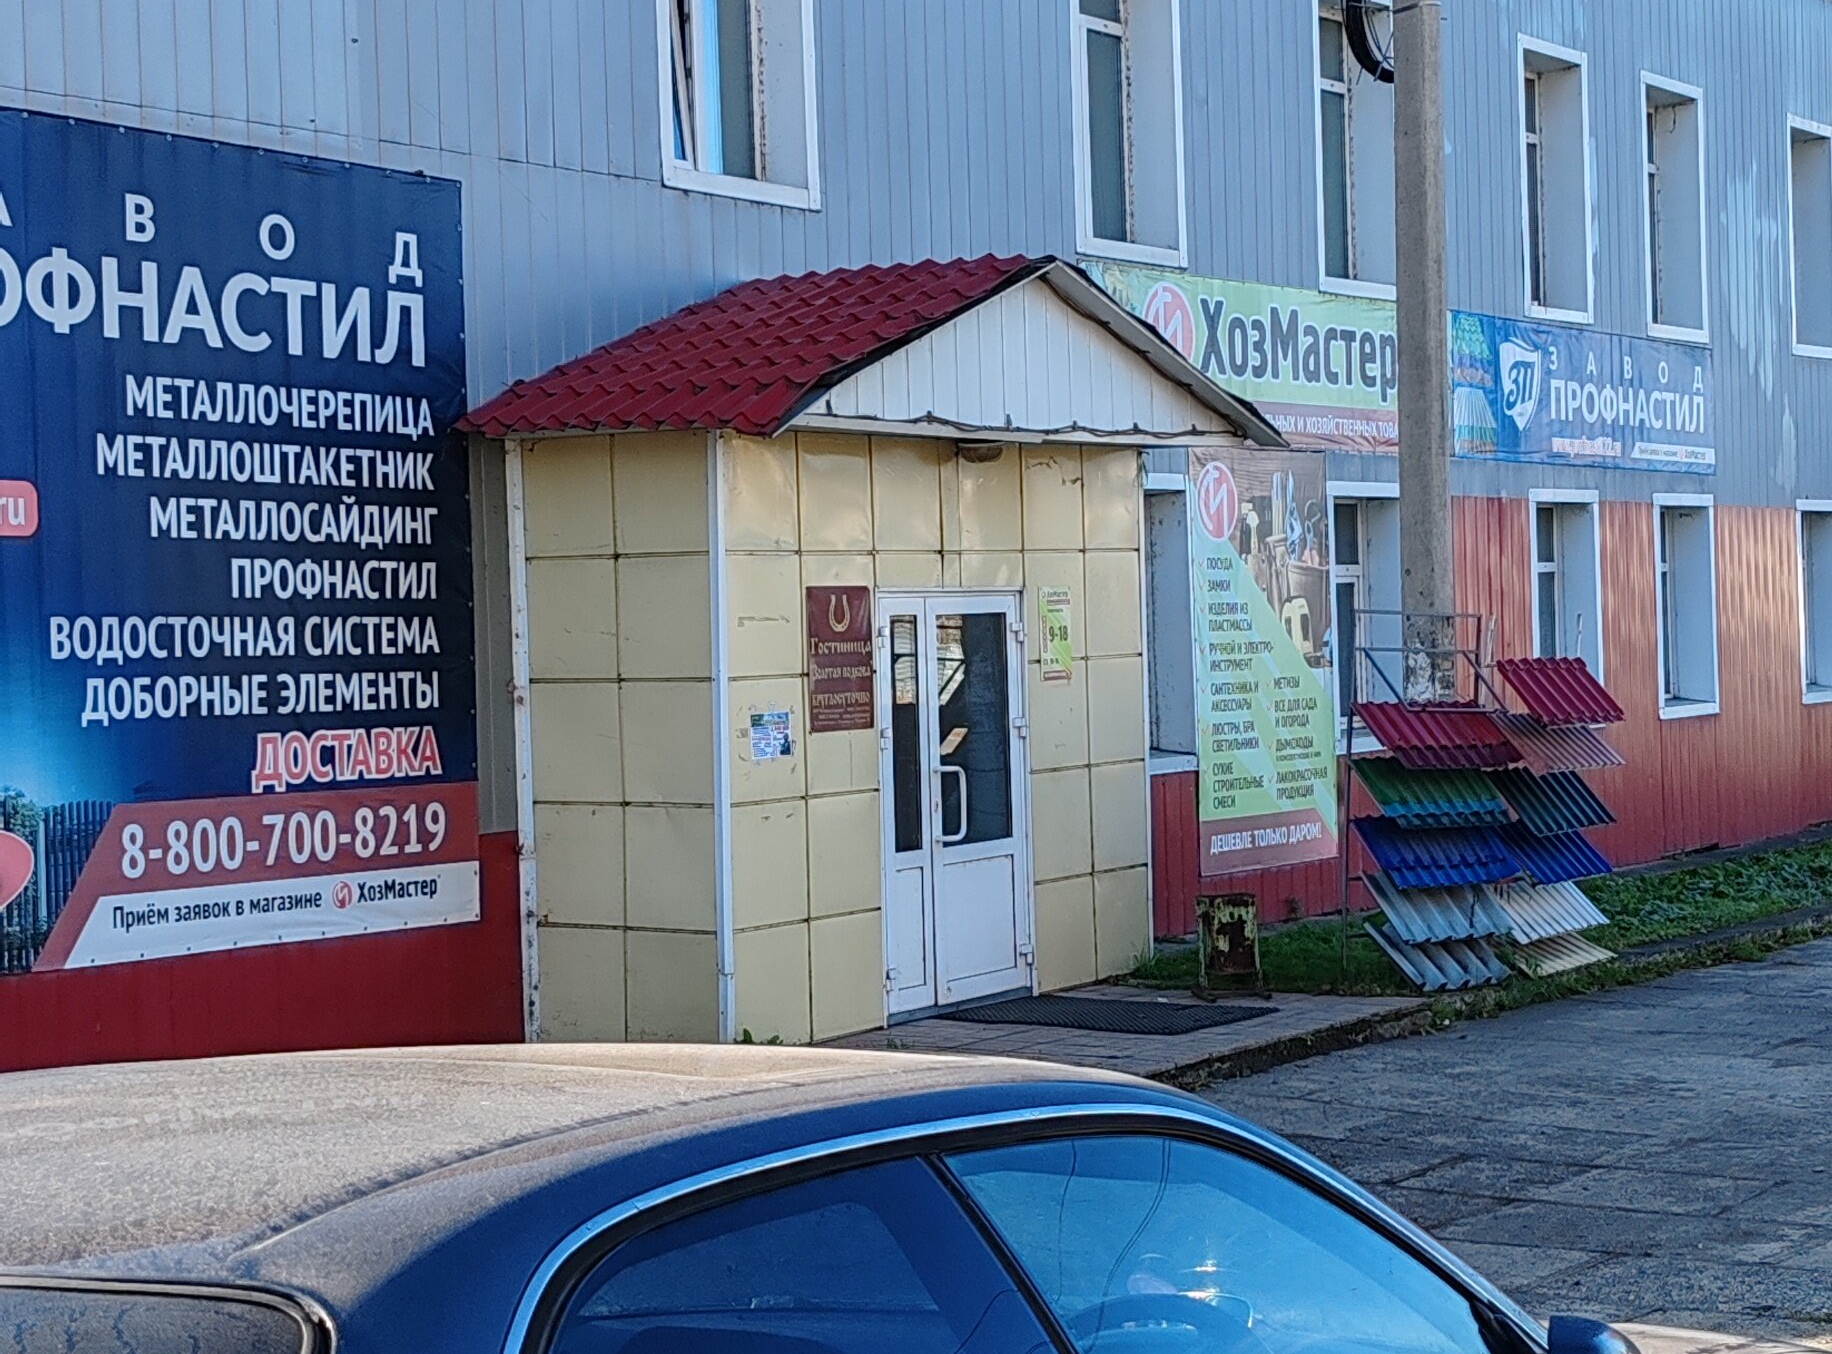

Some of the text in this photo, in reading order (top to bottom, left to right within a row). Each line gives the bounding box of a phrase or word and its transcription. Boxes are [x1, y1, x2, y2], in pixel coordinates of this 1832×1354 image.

[1200, 298, 1397, 403] ХозМастер
[126, 374, 435, 441] МЕТАЛЛОЧЕРЕПИЦА
[1298, 416, 1305, 433] И
[1306, 415, 1377, 437] ХОЗЯЙСТВЕННЫХ
[1550, 379, 1704, 433] ПРОФНАСТИЛ
[96, 433, 435, 491] МЕТАЛЛОШТАКЕТНИК
[150, 496, 438, 550] МЕТАЛЛОСАЙДИНГ
[230, 558, 437, 600] ПРОФНАСТИЛ
[1206, 557, 1233, 571] ПОСУДА
[1207, 580, 1231, 592] ЗАМКИ
[50, 615, 440, 666] ВОДОСТОЧНАЯ СИСТЕМА
[810, 637, 871, 656] Гостиница
[1049, 625, 1068, 642] 9-18
[81, 671, 440, 727] ДОБОРНЫЕ ЭЛЕМЕНТЫ
[251, 725, 443, 793] ДОСТАВКА
[121, 801, 447, 879] 8-800-700-8219
[1210, 822, 1322, 856] ДЕШЕВЛЕ ТОЛЬКО ДАРОМ!
[113, 877, 438, 932] Приём заявок в магазине ХозМастер
